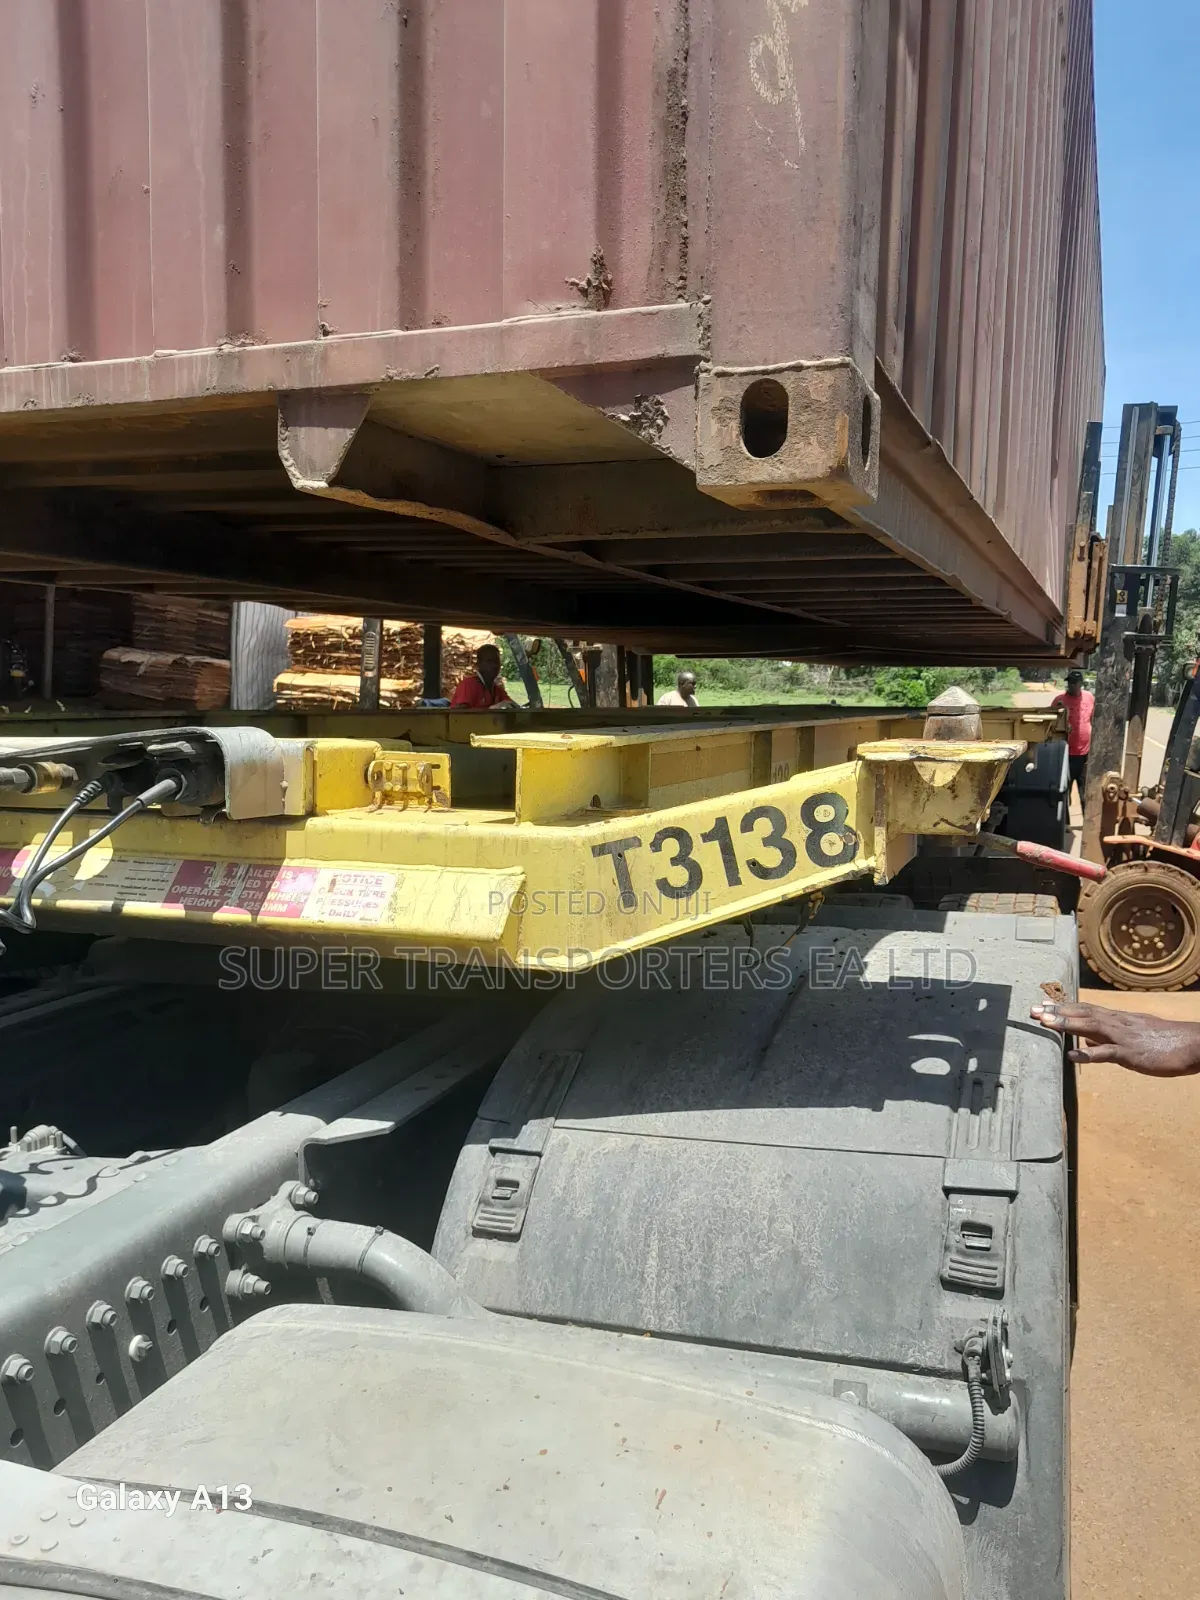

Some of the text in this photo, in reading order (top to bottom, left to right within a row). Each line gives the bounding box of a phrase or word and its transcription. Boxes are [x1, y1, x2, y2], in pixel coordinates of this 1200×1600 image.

[591, 792, 860, 909] T3138
[232, 867, 279, 878] TAILER
[265, 881, 281, 890] TO
[331, 874, 385, 885] OTICE
[171, 885, 222, 897] OPERATE
[240, 890, 264, 900] 5TH
[178, 896, 220, 908] HEIGHT
[242, 901, 289, 913] 1250MM
